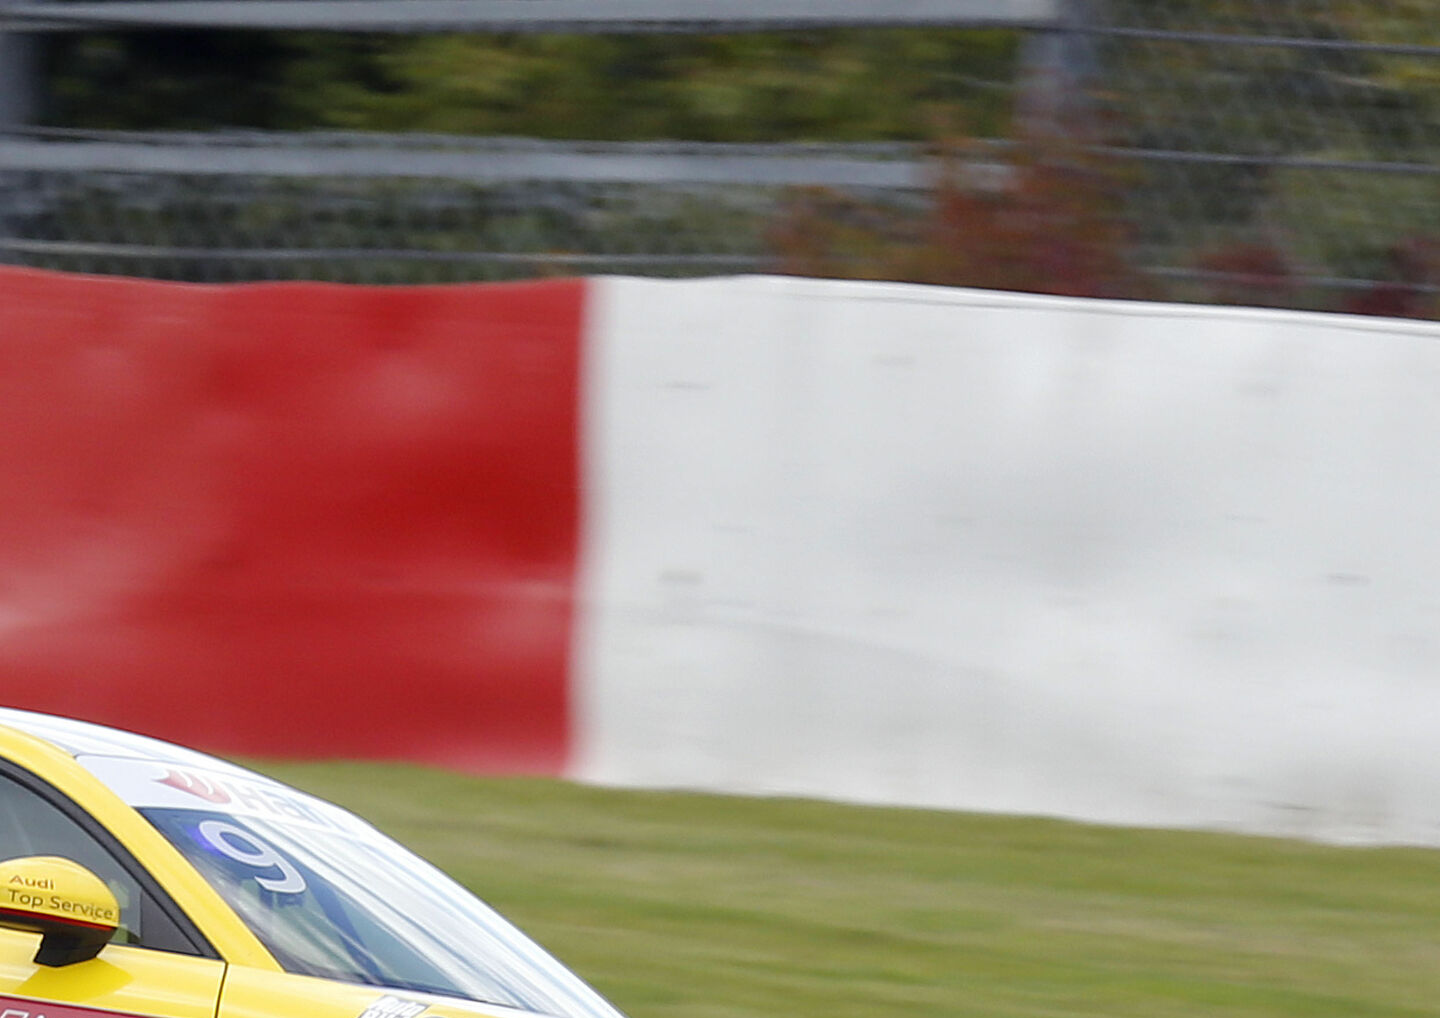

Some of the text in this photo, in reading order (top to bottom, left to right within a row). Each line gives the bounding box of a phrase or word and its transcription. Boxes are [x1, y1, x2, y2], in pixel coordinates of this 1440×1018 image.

[198, 820, 308, 894] 9
[10, 875, 55, 890] Audi
[8, 888, 114, 919] Top Service
